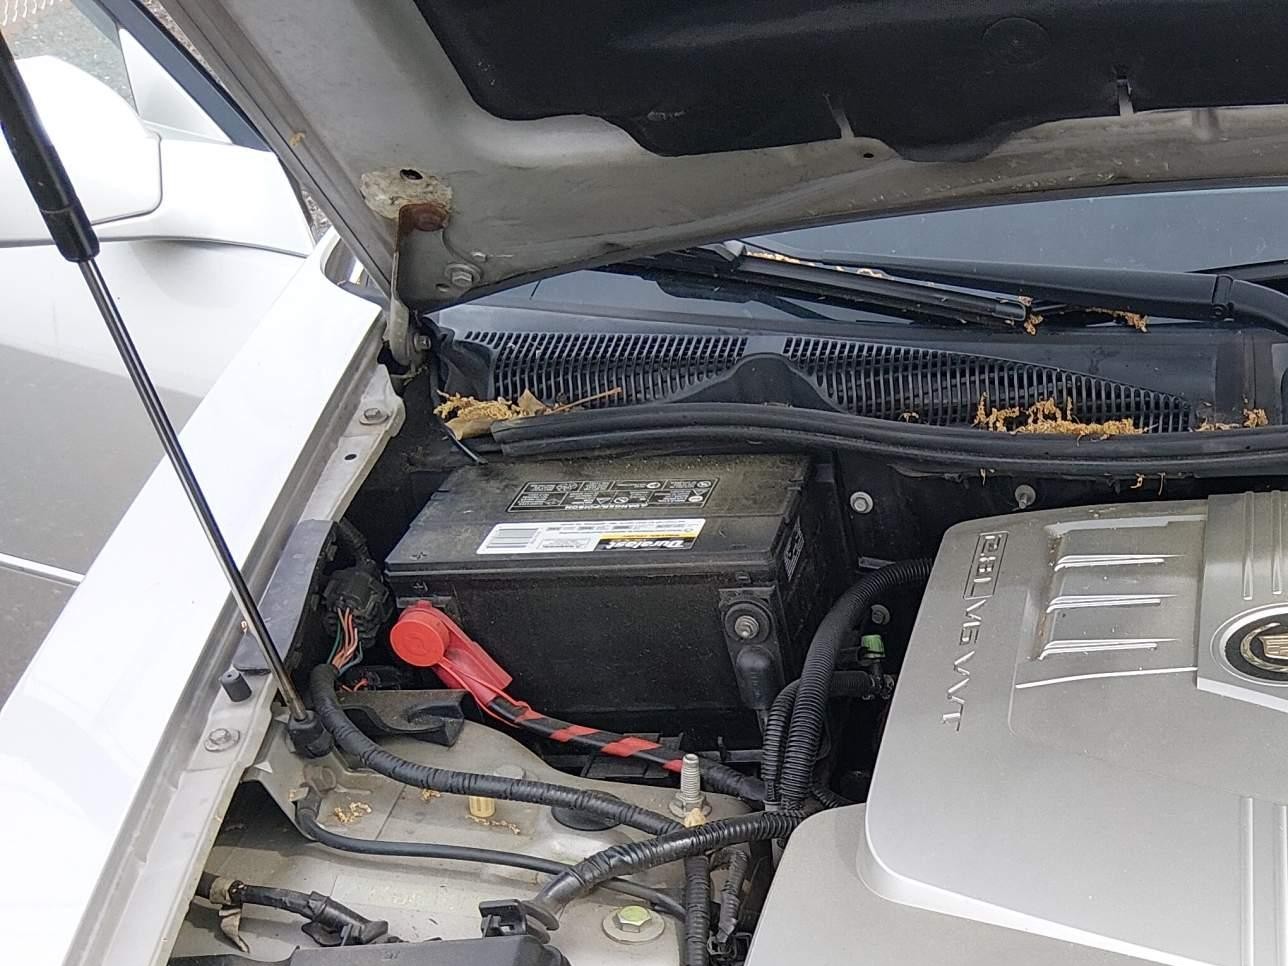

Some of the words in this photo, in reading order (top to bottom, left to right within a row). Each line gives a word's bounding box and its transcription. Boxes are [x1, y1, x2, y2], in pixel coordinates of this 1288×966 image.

[605, 539, 686, 550] Duralast
[959, 600, 986, 645] V6
[942, 650, 975, 732] VVT
